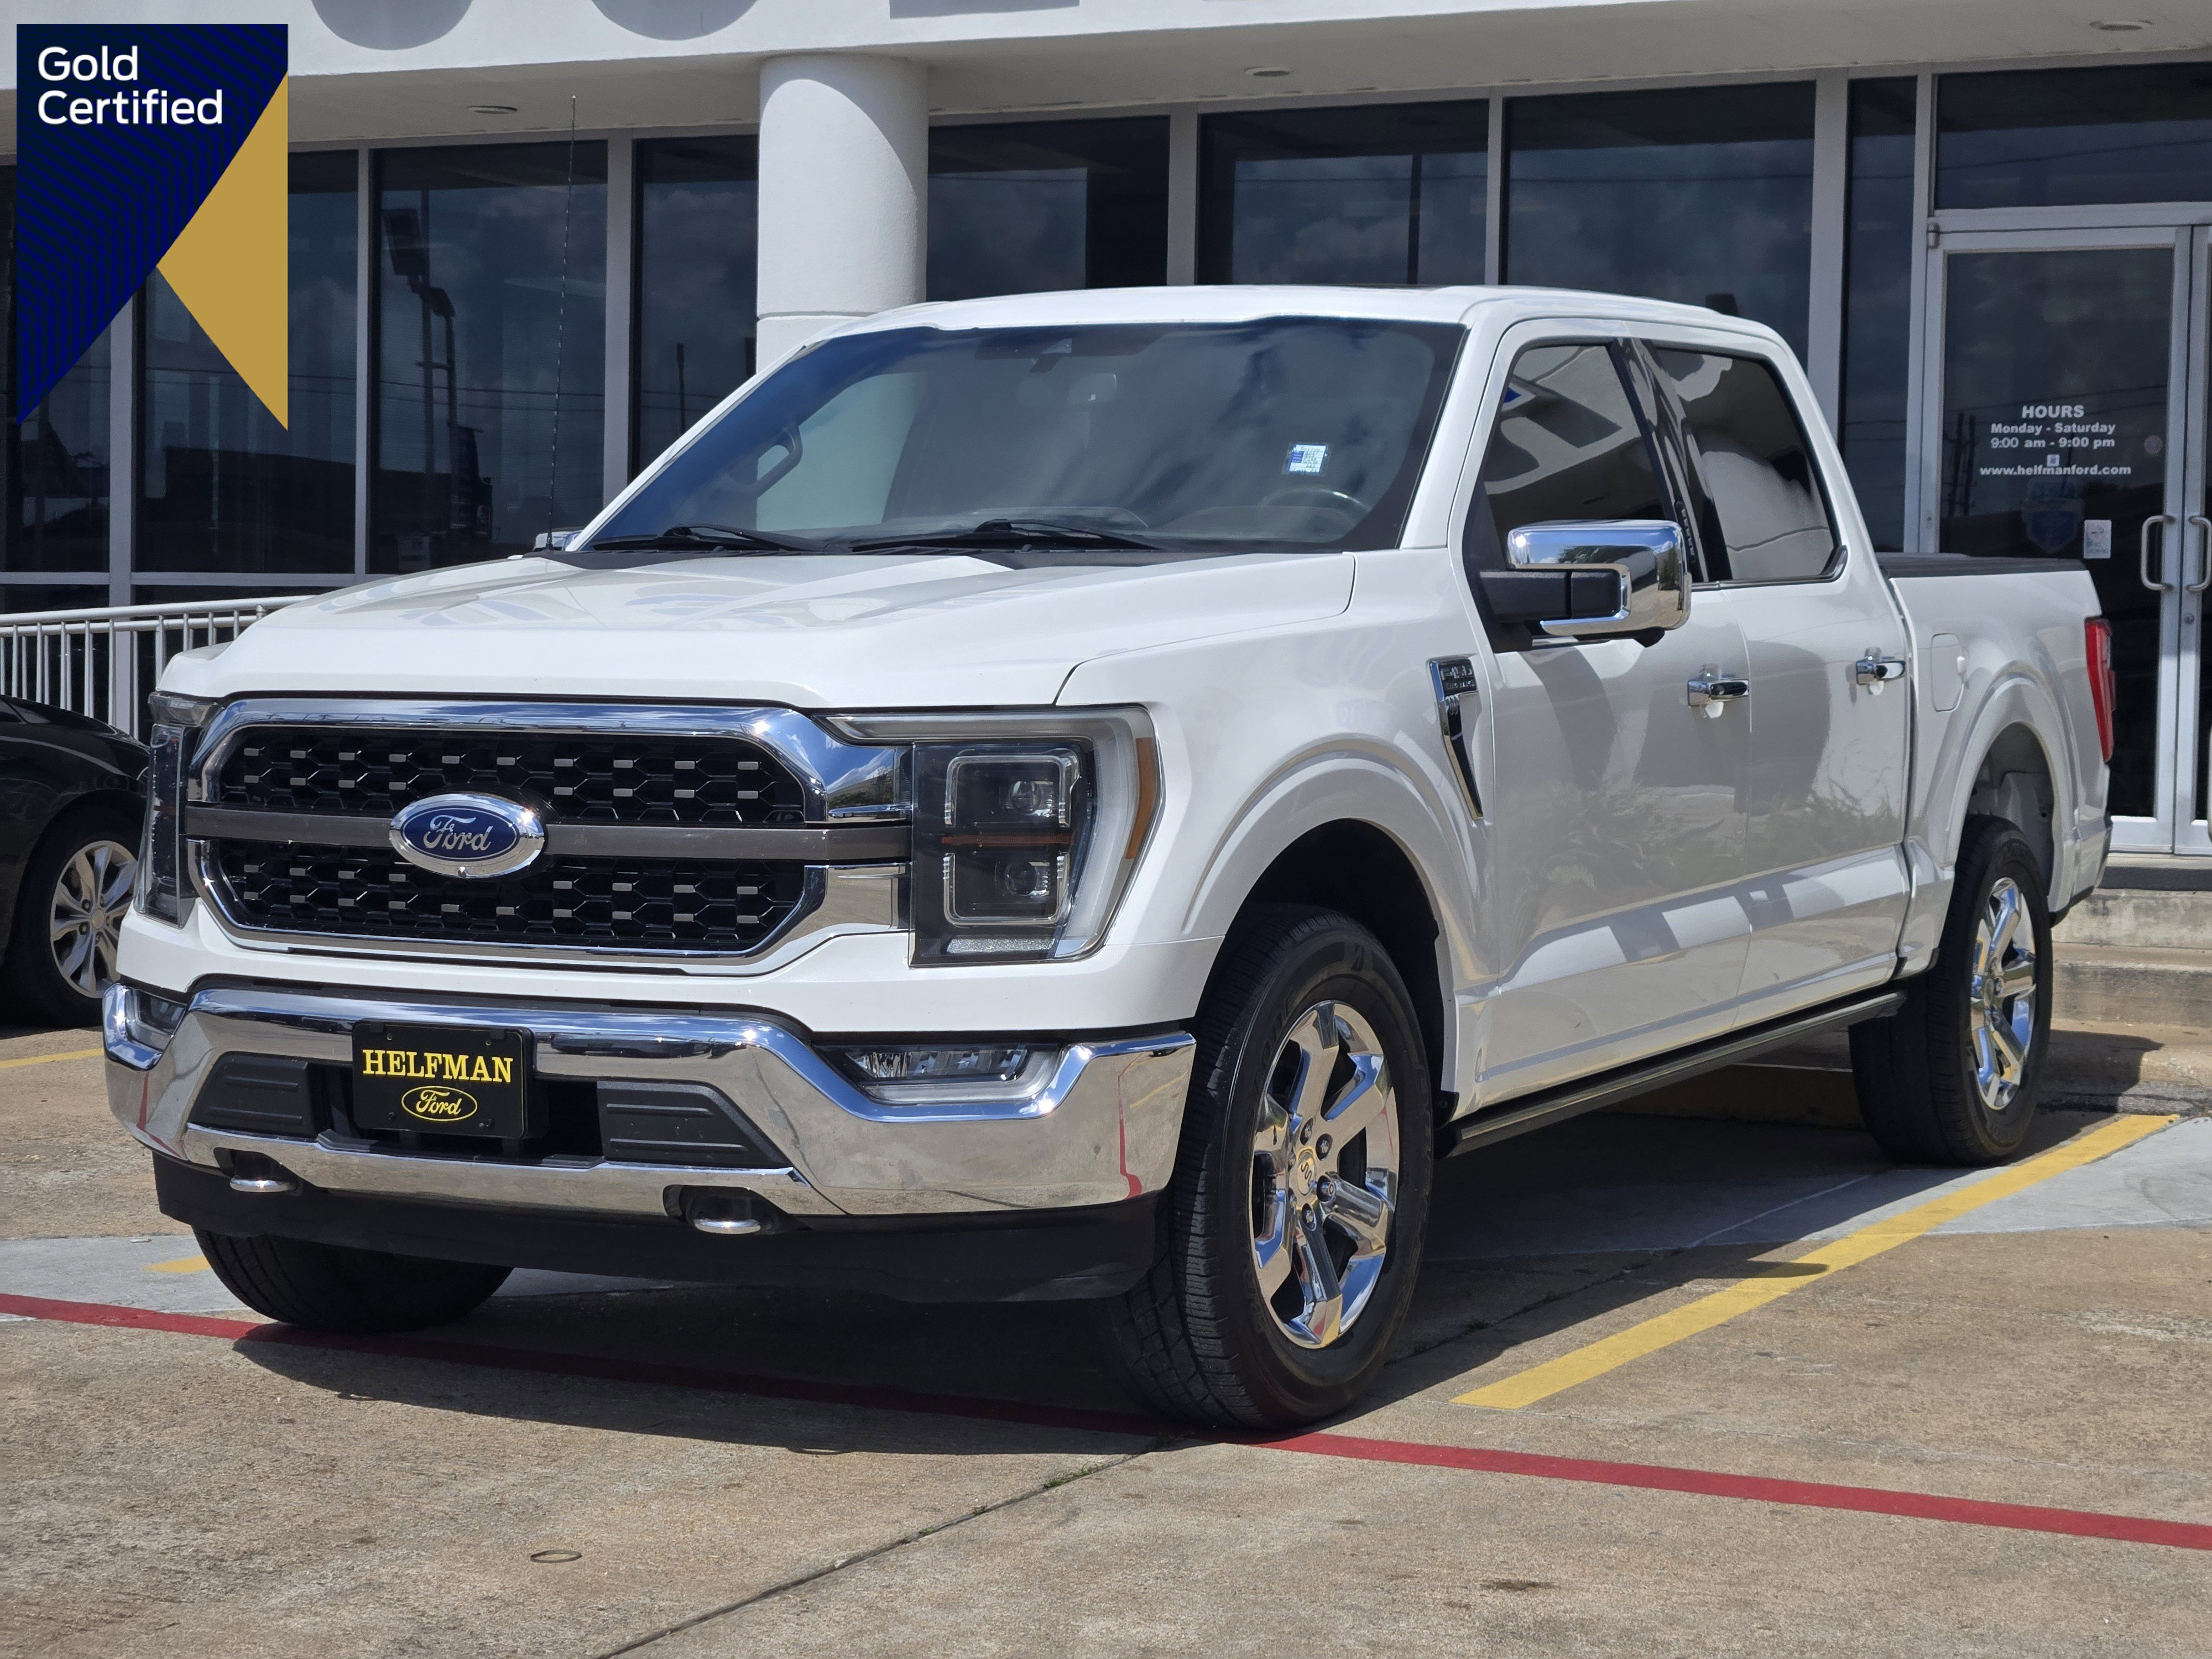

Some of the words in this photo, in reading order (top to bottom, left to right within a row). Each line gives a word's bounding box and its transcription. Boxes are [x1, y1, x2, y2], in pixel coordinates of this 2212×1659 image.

[2022, 405, 2084, 419] HOURS
[1991, 423, 2043, 436] Monday
[2054, 422, 2116, 435] Saturday
[1991, 437, 2019, 448] 9:00
[2024, 440, 2046, 448] am
[2058, 437, 2089, 447] 9:00
[2093, 439, 2115, 450] pm
[1980, 464, 2131, 476] www.helfmanford.com
[423, 815, 493, 851] Ford
[362, 1049, 513, 1083] HELFMAN
[415, 1089, 462, 1115] Ford
